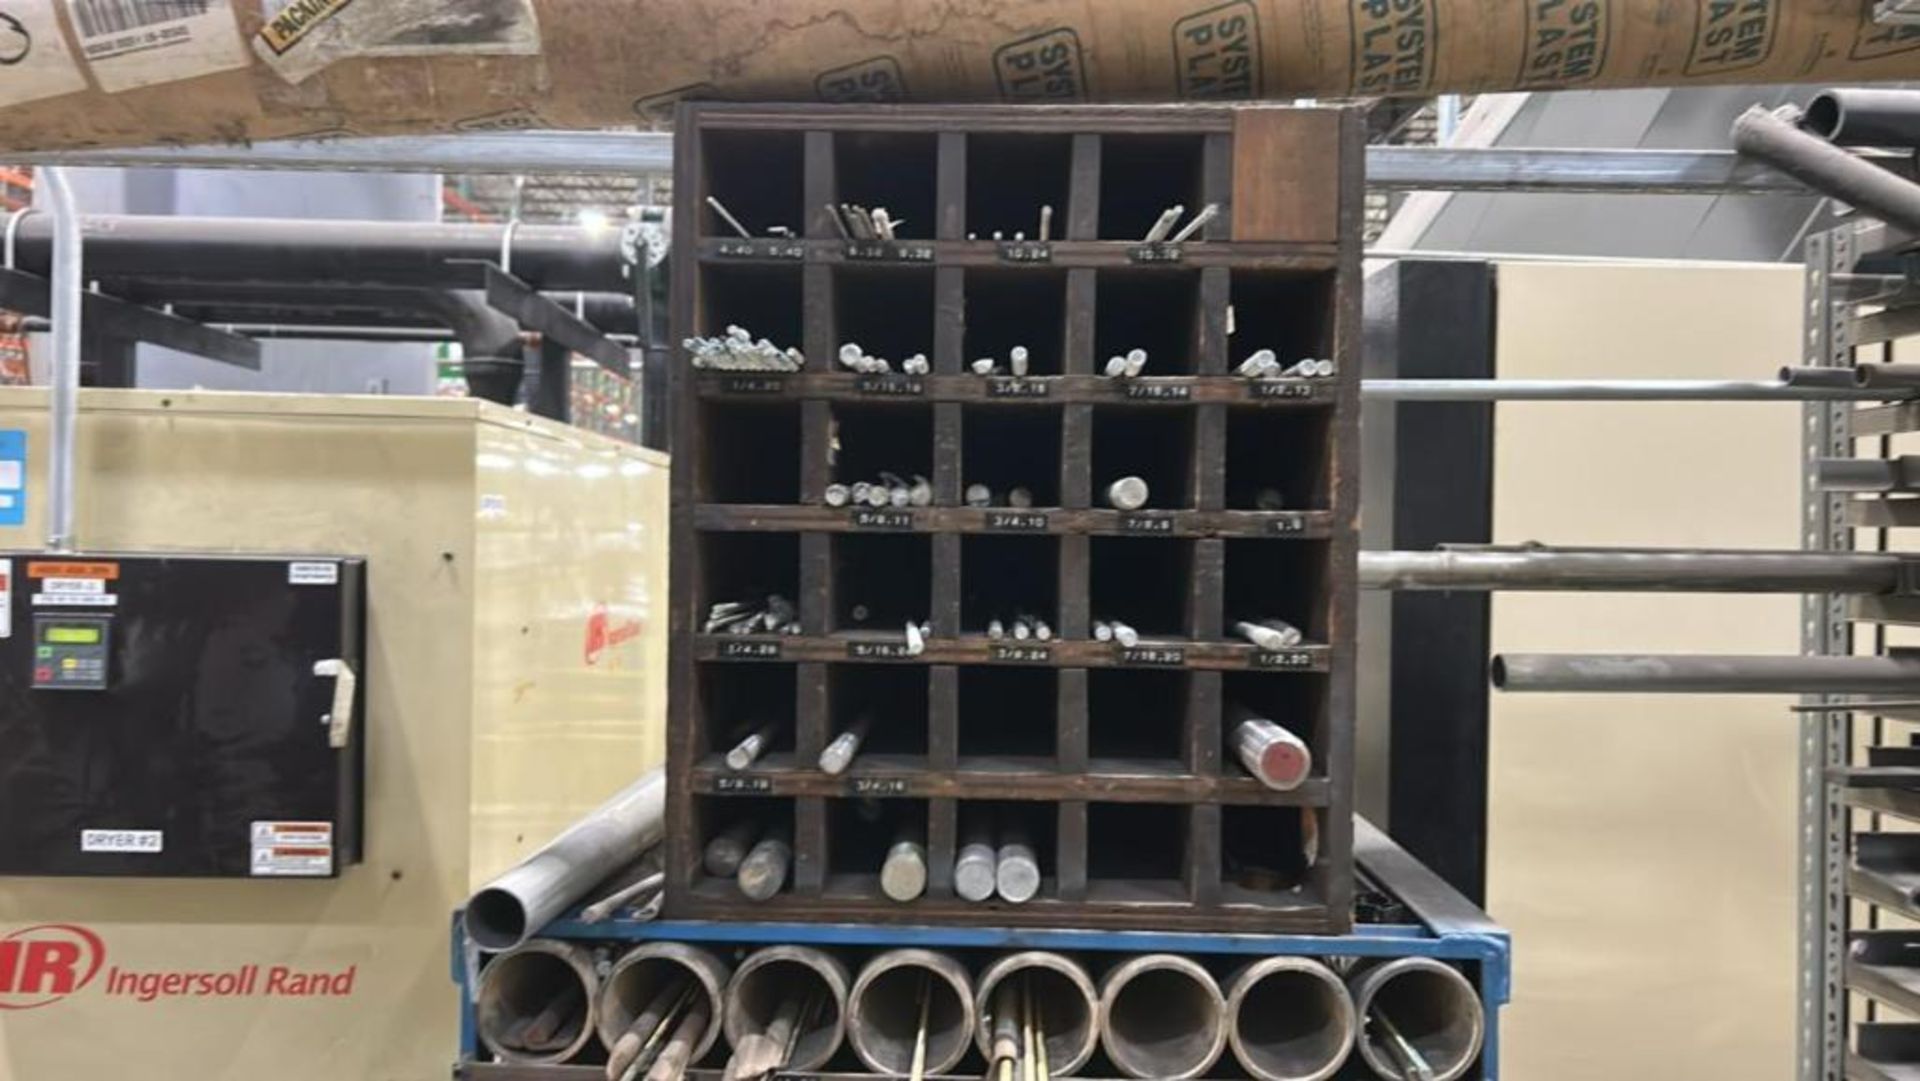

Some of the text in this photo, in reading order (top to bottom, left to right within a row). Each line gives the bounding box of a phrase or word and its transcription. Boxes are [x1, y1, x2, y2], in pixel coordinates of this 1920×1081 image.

[271, 0, 334, 40] PACKIN
[1529, 0, 1566, 81] LAST
[1562, 0, 1599, 77] STEM
[1699, 0, 1734, 63] AST
[87, 833, 158, 848] DRYER #2
[106, 965, 356, 1001] Ingersoll Rand
